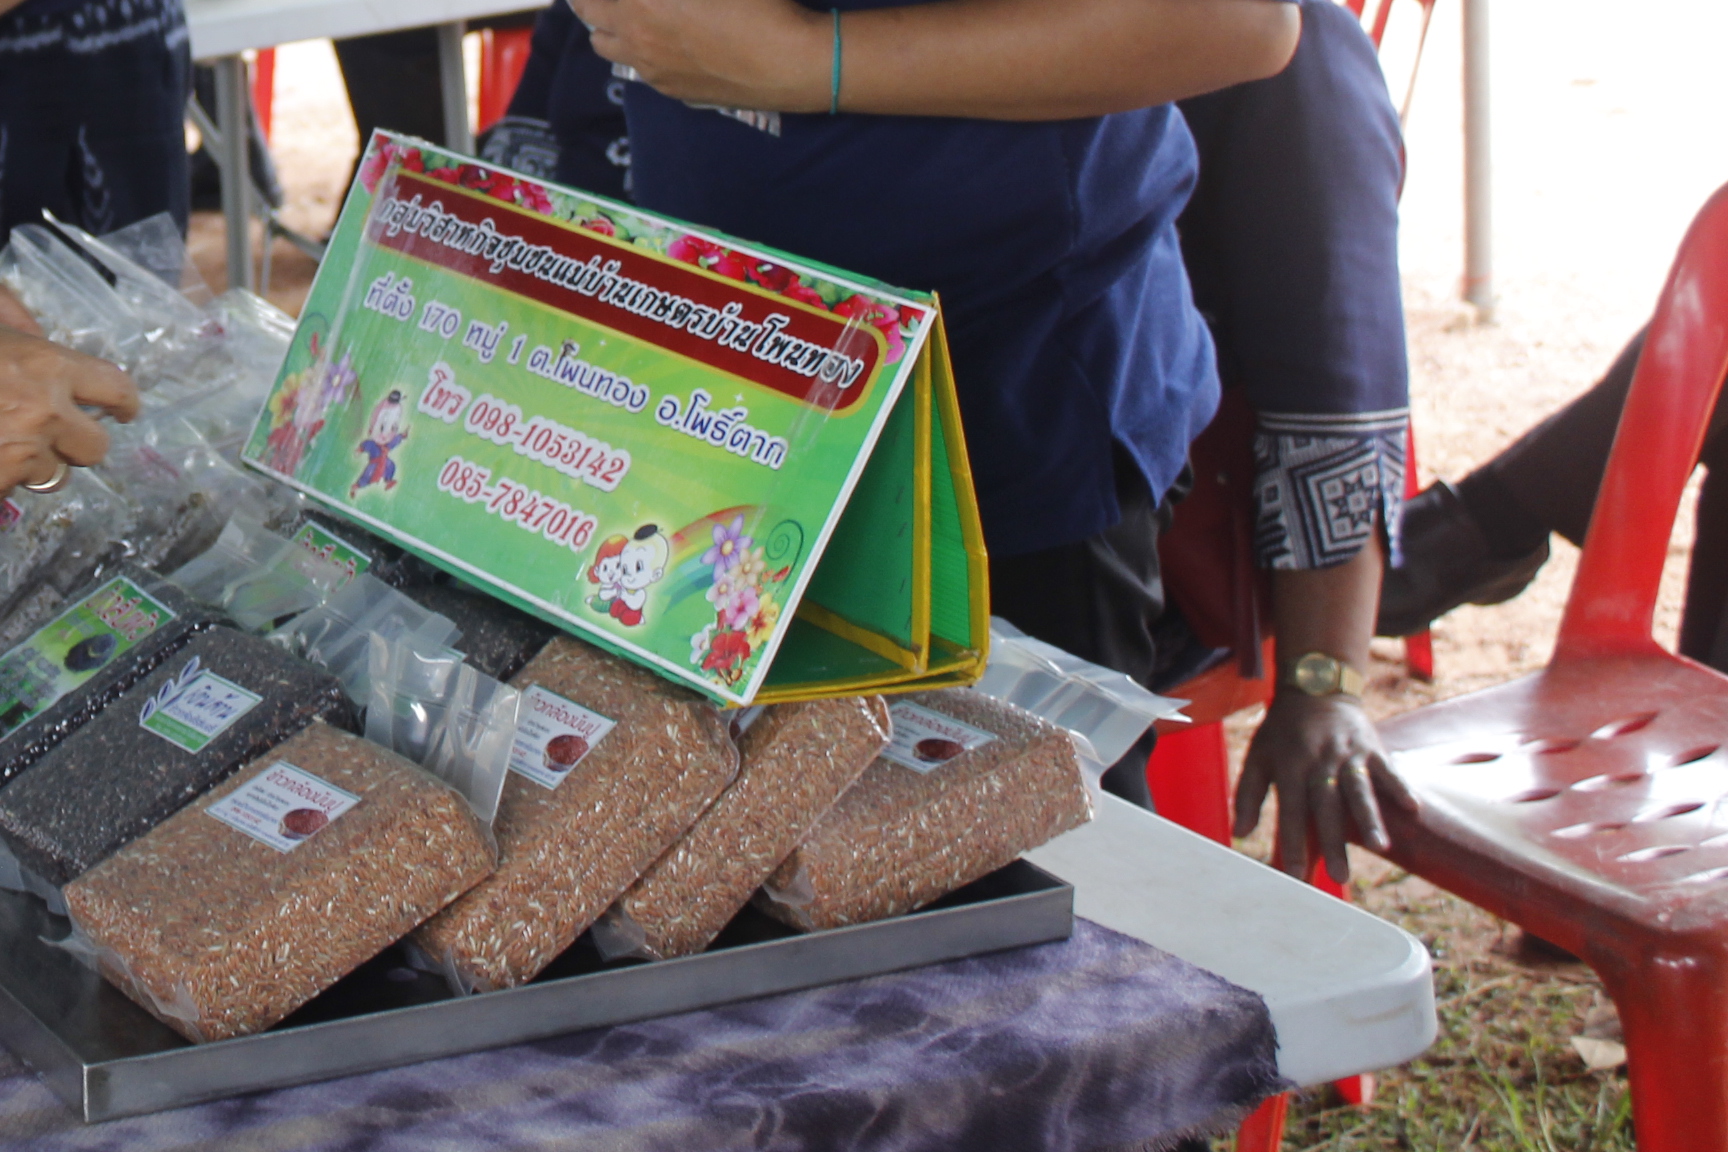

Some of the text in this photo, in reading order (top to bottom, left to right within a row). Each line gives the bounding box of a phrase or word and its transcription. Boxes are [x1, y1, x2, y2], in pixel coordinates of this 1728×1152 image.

[365, 272, 415, 321] ที่ตั้ง
[420, 299, 461, 339] 170
[464, 320, 507, 362] หมู่
[468, 400, 626, 485] 098-1053142
[439, 460, 595, 548] 085-7847016
